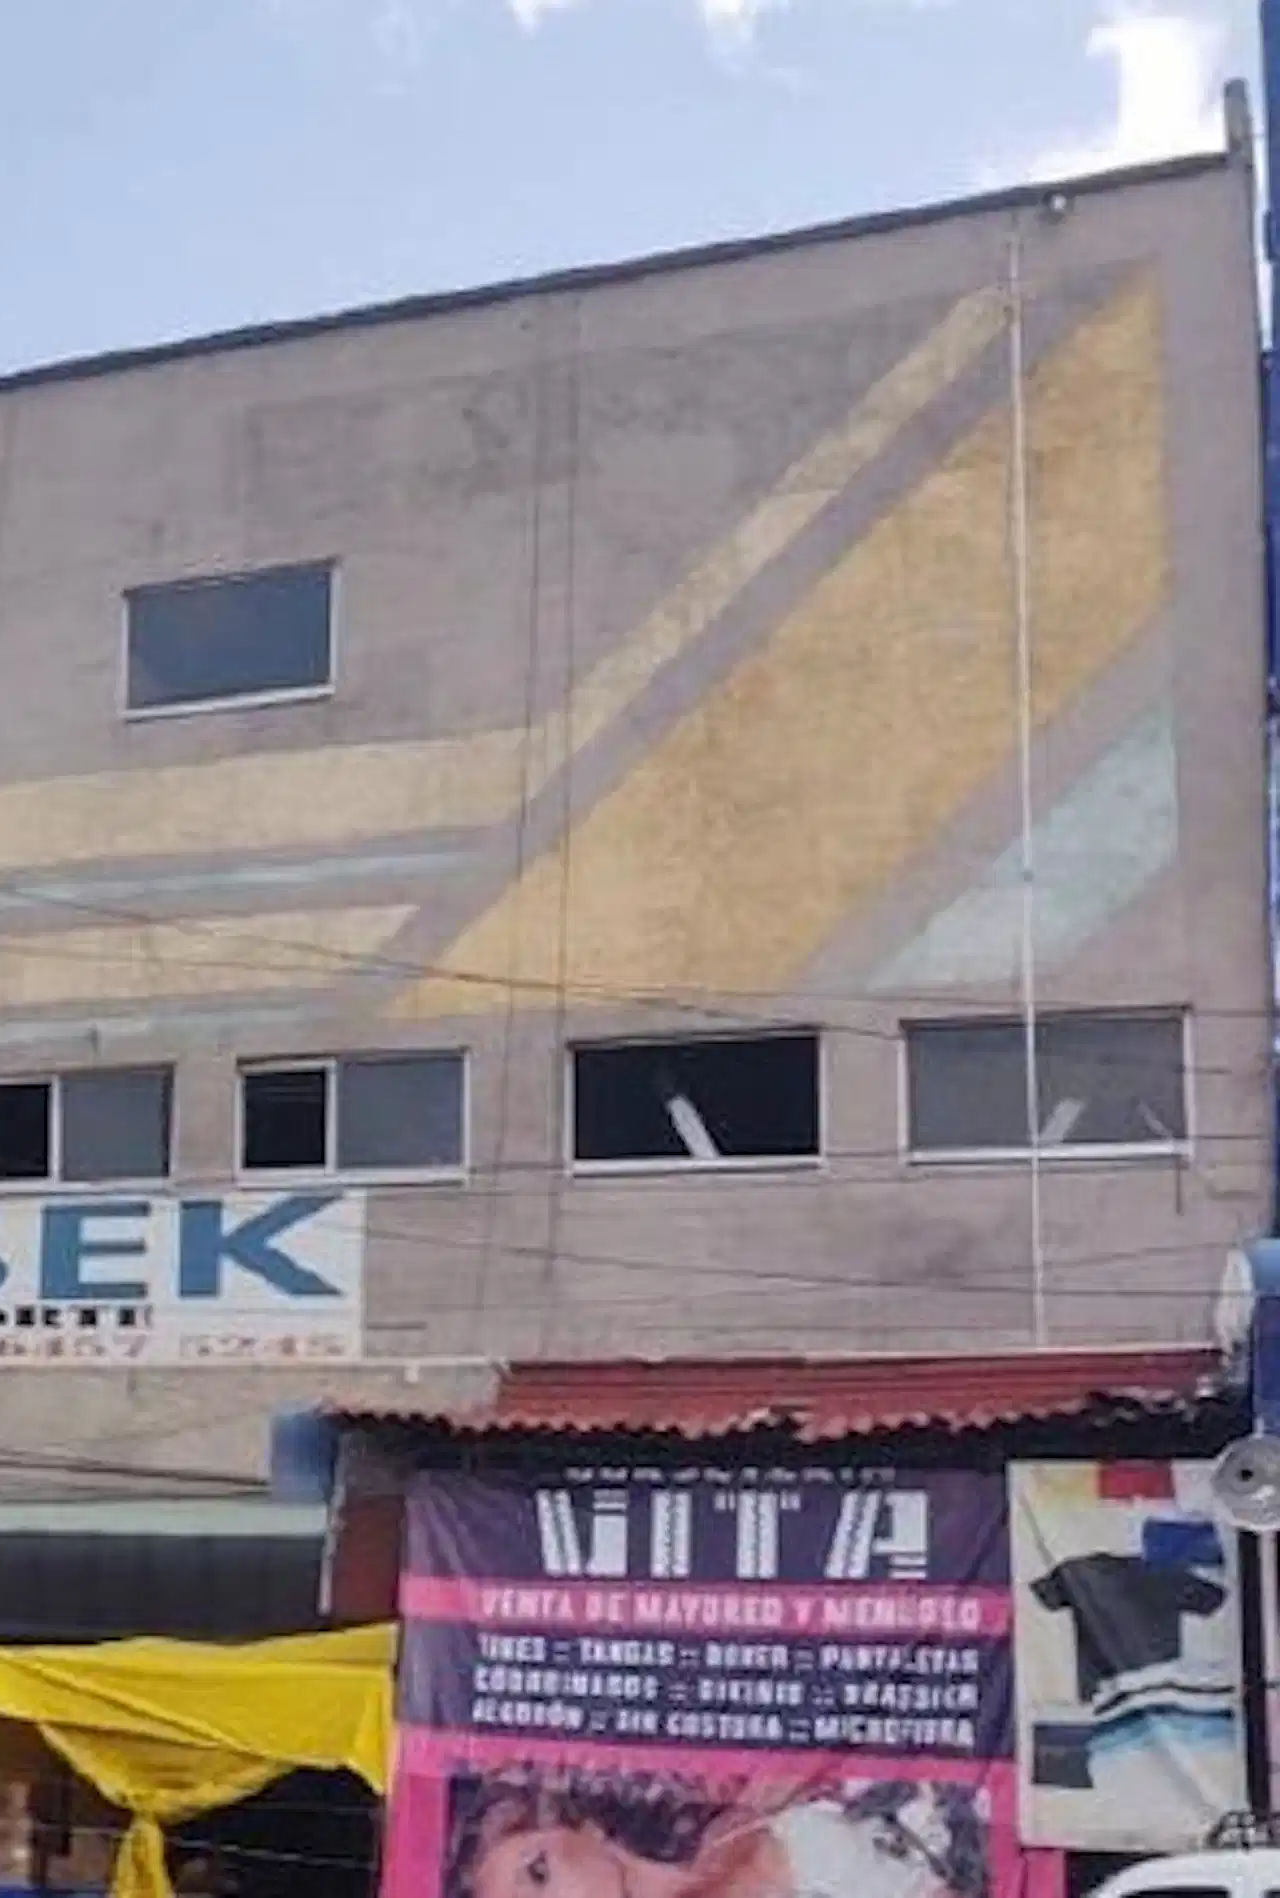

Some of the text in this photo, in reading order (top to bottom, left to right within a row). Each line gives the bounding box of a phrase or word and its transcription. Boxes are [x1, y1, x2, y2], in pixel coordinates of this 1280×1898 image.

[536, 1487, 929, 1580] VITA
[481, 1588, 573, 1621] VENTA
[585, 1590, 626, 1622] DE
[633, 1592, 782, 1629] MAYOREO
[793, 1597, 816, 1627] Y
[578, 1637, 676, 1667] TANGAS
